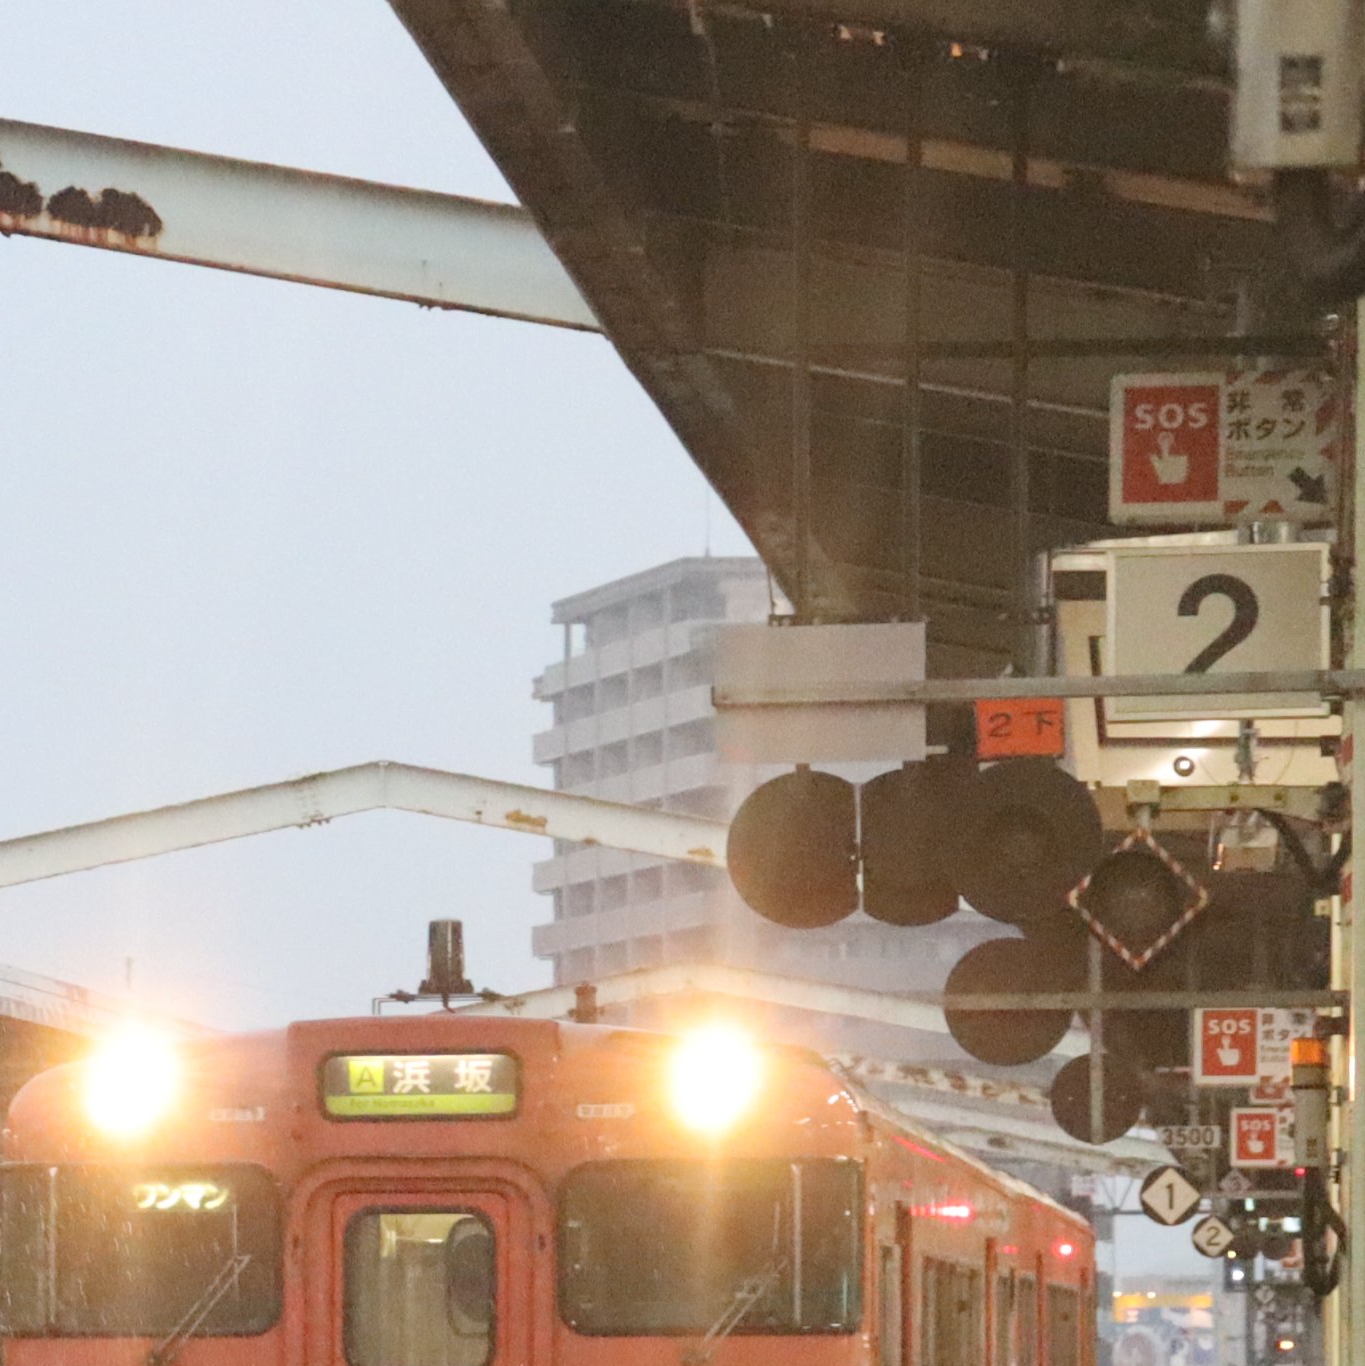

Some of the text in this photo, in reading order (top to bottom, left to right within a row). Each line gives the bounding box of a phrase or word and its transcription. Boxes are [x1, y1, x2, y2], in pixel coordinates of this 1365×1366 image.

[1135, 403, 1209, 430] SOS
[1227, 418, 1307, 441] ボタン
[1177, 573, 1260, 675] 2
[988, 709, 1058, 737] 2 下
[1208, 1018, 1252, 1035] SOS
[356, 1060, 494, 1094] A 浜坂
[1241, 1119, 1271, 1131] SOS
[132, 1183, 229, 1210] ワンマン
[1165, 1182, 1175, 1211] 1
[1205, 1225, 1221, 1247] 2
